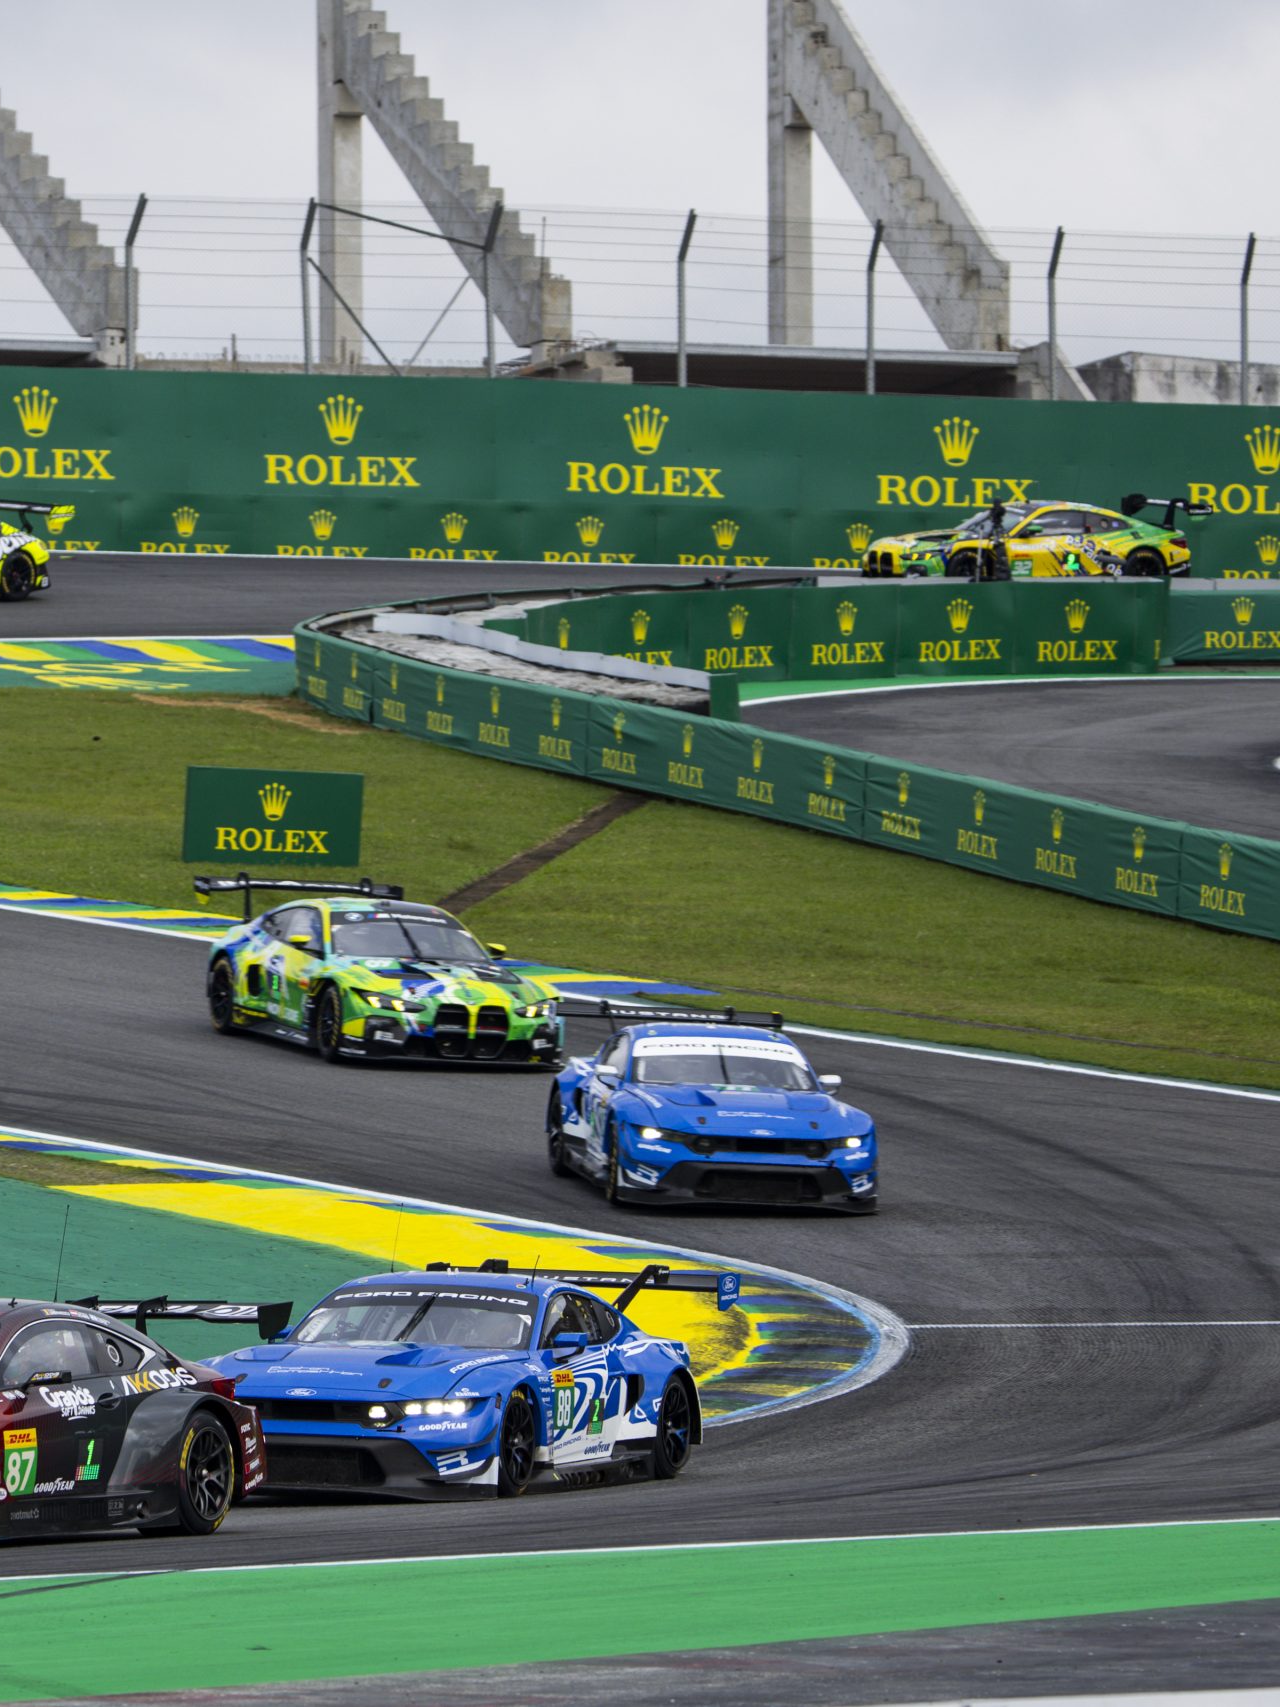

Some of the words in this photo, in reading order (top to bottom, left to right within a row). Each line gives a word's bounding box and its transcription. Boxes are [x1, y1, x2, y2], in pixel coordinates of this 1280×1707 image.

[264, 454, 420, 487] ROLEX
[567, 462, 724, 498] ROLEX
[878, 475, 1033, 508] ROLEX
[704, 646, 774, 670] ROLEX
[811, 641, 885, 665] ROLEX
[919, 639, 1001, 662] ROLEX
[1038, 640, 1118, 662] ROLEX
[538, 735, 572, 760] ROLEX
[602, 748, 637, 775] ROLEX
[668, 762, 704, 789] ROLEX
[737, 777, 774, 804] ROLEX
[808, 792, 846, 821] ROLEX
[882, 811, 921, 840] ROLEX
[215, 827, 330, 854] ROLEX
[957, 829, 998, 859] ROLEX
[1035, 848, 1077, 879] ROLEX
[1115, 867, 1158, 897] ROLEX
[1200, 884, 1245, 916] ROLEX
[334, 1291, 413, 1301] FORD
[418, 1291, 529, 1306] RACING
[449, 1360, 477, 1374] FORD
[475, 1354, 509, 1366] RACING
[120, 1366, 198, 1396] AKKODIS
[555, 1373, 573, 1384] DHL
[556, 1389, 572, 1427] 88
[592, 1399, 600, 1422] 2
[8, 1432, 33, 1444] DHL
[418, 1420, 468, 1431] GOODYEAR
[86, 1438, 95, 1465] 1
[5, 1449, 36, 1494] 87
[33, 1477, 75, 1495] GOODYEAR
